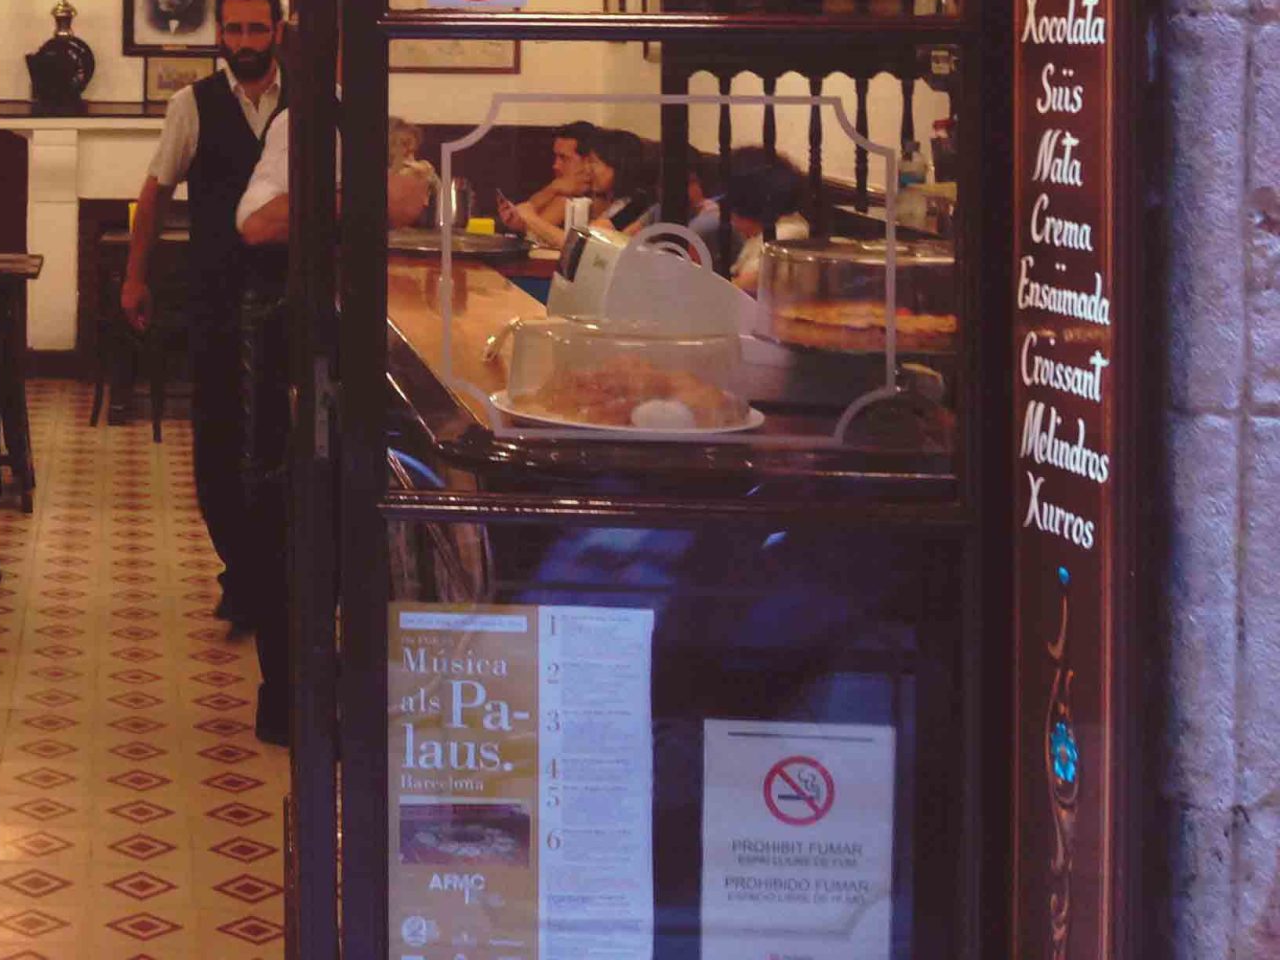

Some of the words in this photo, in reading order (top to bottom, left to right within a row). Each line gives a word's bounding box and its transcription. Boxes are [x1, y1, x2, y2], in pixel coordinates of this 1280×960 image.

[1032, 128, 1083, 187] Nata
[1030, 192, 1094, 252] Crema
[1017, 255, 1111, 326] Ensaïmada
[1020, 330, 1110, 403] Croissant
[1020, 399, 1110, 484] Melindros
[1022, 470, 1095, 550] Xurros
[402, 646, 509, 678] Música
[400, 687, 441, 713] als
[808, 841, 863, 857] FUMAR
[814, 878, 870, 893] FUMAR
